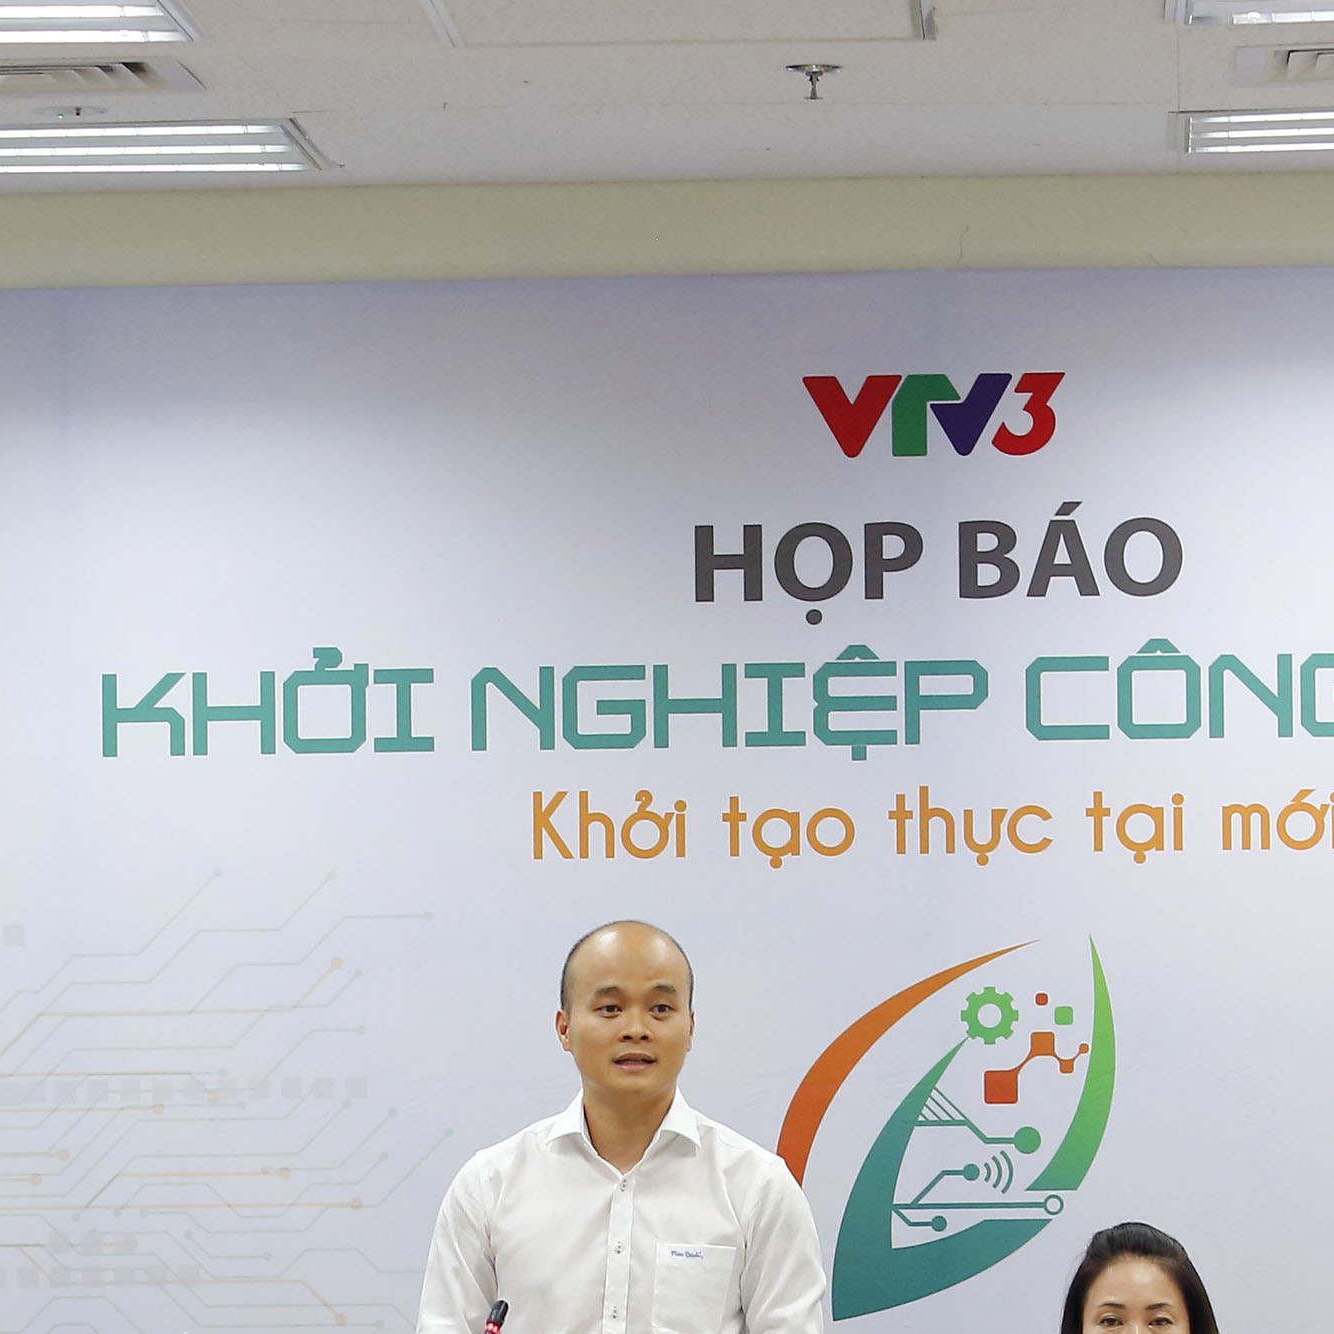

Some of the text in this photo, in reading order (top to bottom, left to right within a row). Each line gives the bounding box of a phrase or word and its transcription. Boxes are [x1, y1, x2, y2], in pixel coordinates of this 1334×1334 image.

[803, 372, 1065, 458] VTV3
[694, 501, 1185, 625] HỌP BÁO
[101, 646, 435, 757] KHỞI
[470, 644, 989, 761] NGHIỆP
[532, 789, 688, 860] Khởi
[721, 795, 856, 870] tạo
[887, 785, 1054, 867] thực
[1085, 790, 1185, 865] tại
